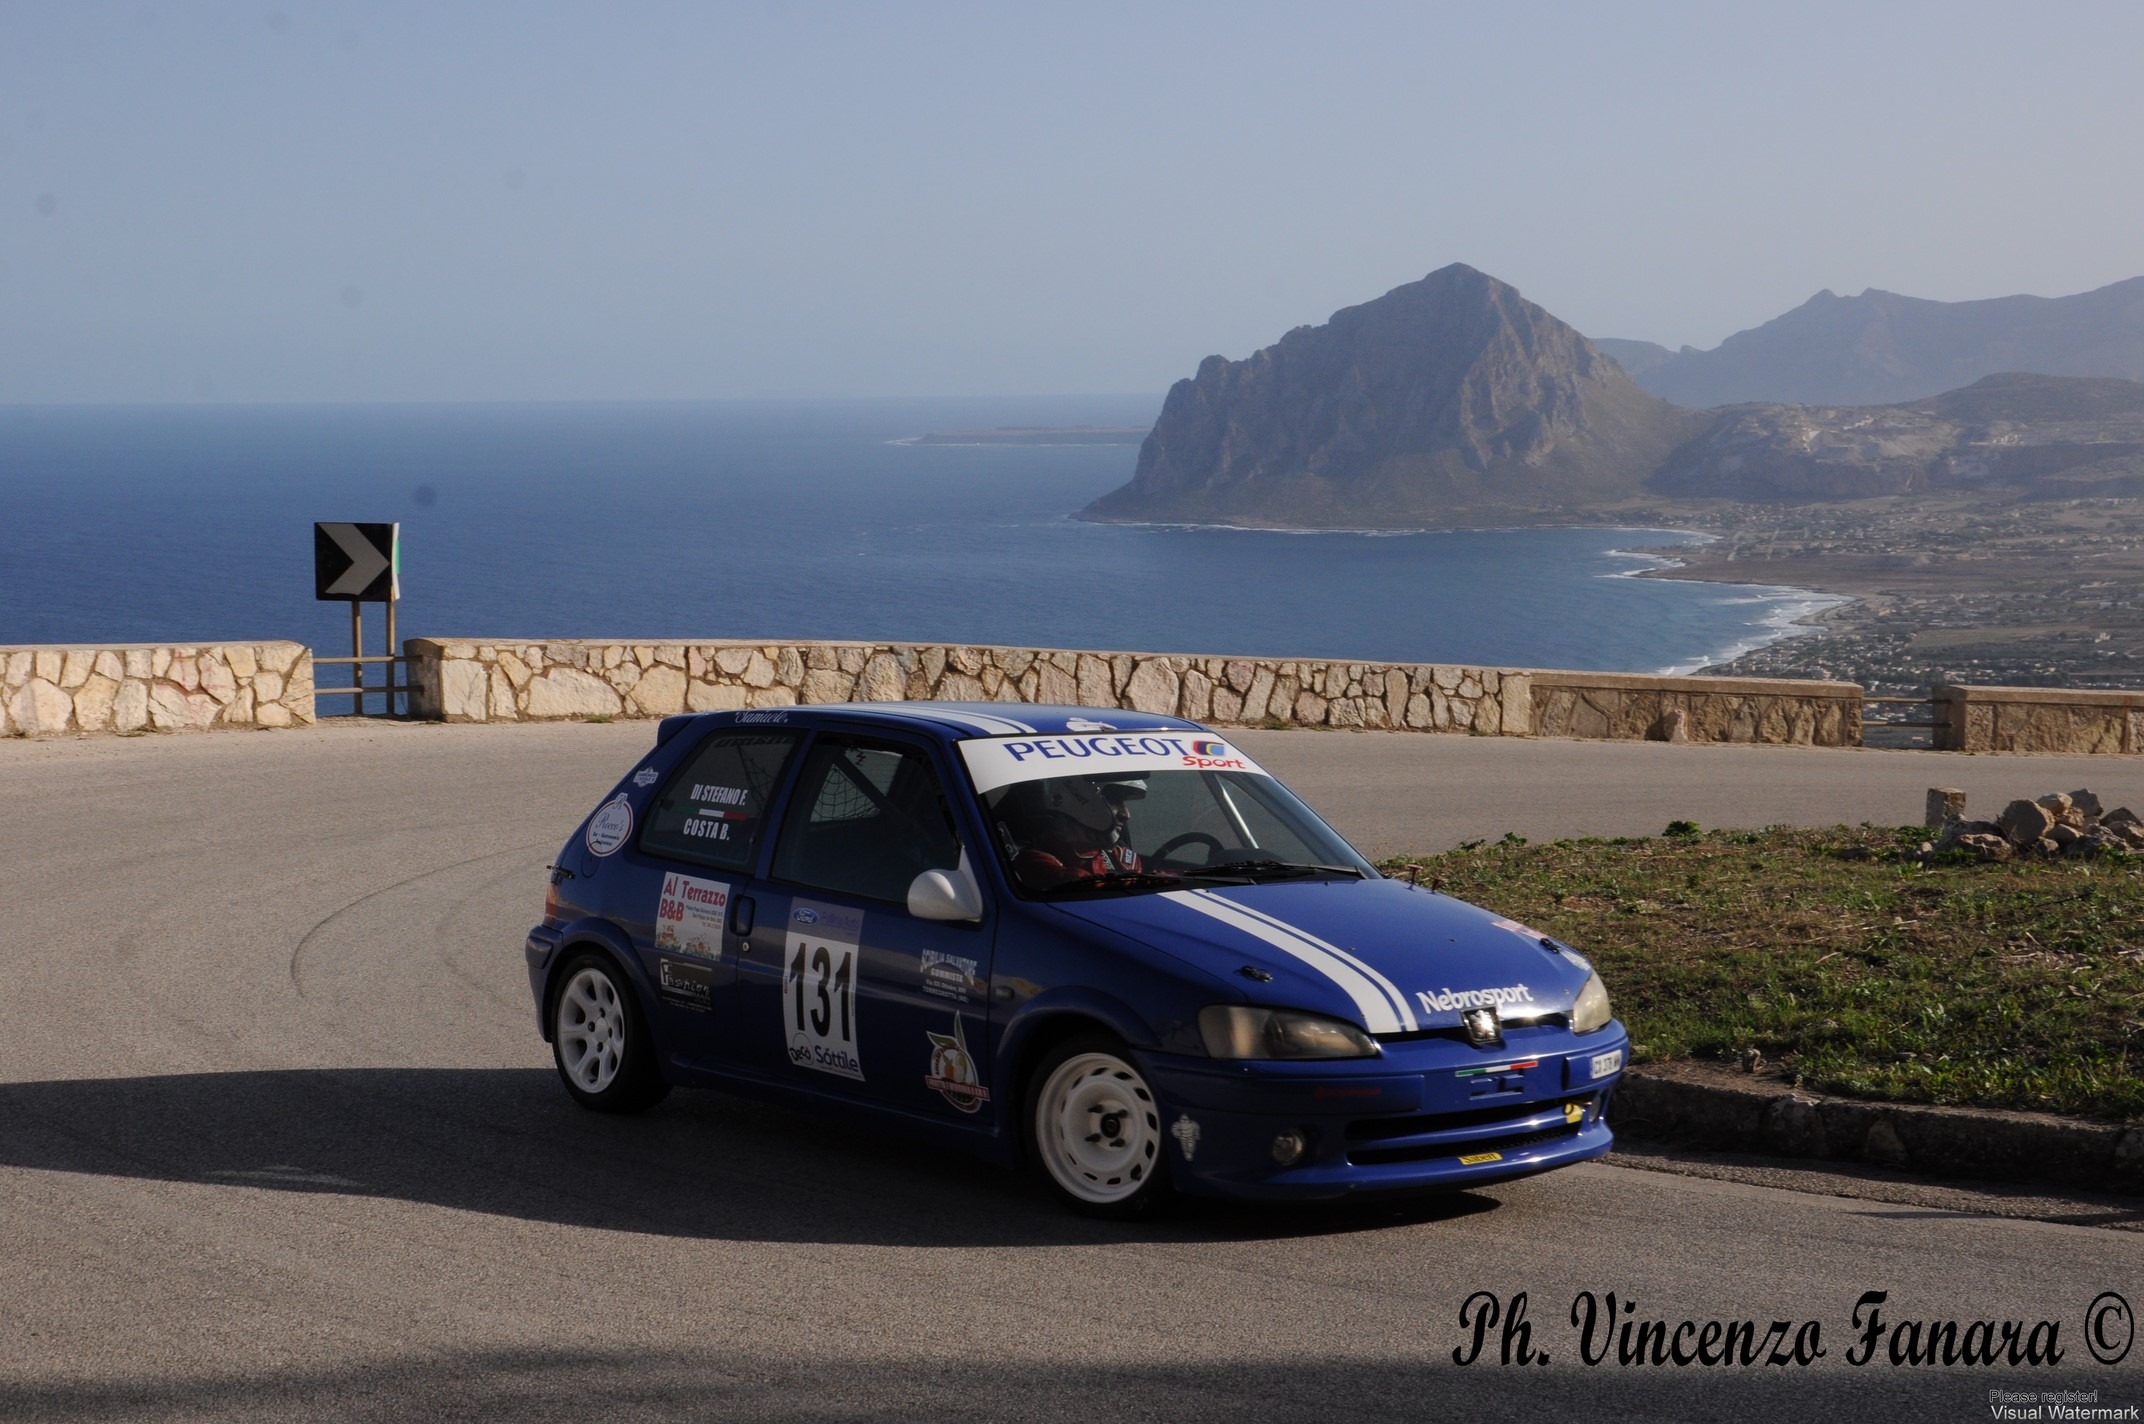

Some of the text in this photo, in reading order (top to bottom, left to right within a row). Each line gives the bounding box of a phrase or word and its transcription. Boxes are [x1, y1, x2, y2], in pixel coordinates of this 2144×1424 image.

[1003, 737, 1189, 761] PEUGEOT
[1182, 756, 1246, 769] Sport
[690, 784, 749, 806] DI STEFANO F.
[683, 818, 730, 841] COSTA B.
[663, 876, 726, 907] Al Terrazzo
[659, 898, 684, 922] B&B
[796, 910, 815, 924] Ford
[789, 942, 852, 1042] 131
[1415, 983, 1534, 1014] Nebrosport
